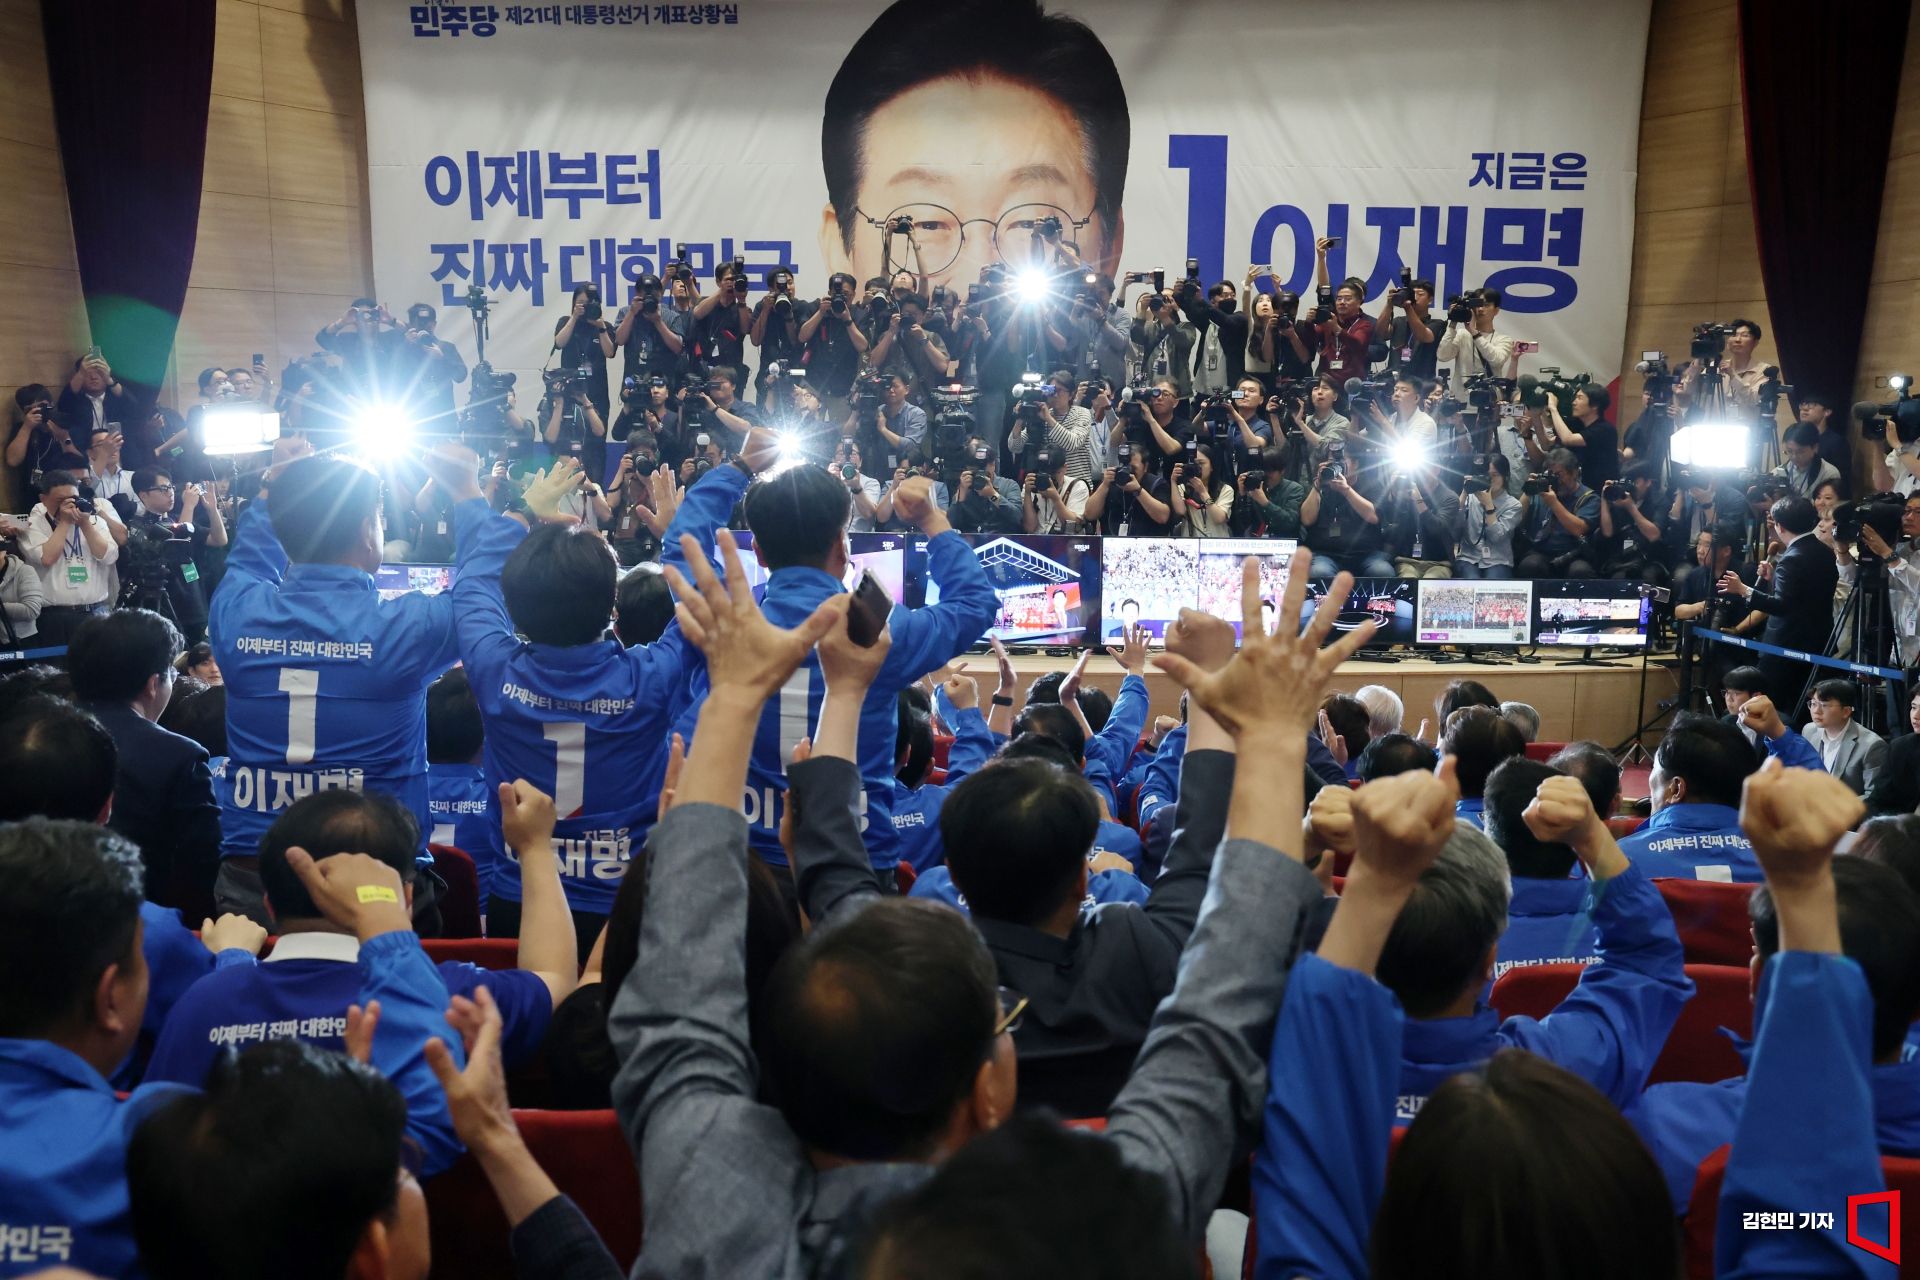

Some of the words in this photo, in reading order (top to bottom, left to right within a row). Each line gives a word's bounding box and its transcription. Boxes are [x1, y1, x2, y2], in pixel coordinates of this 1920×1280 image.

[410, 5, 499, 37] 민주당
[505, 5, 561, 25] 제21대
[565, 5, 649, 25] 대통령선거
[653, 5, 738, 25] 개표상황실
[424, 149, 662, 221] 이제부터
[1469, 152, 1588, 191] 지금은
[1168, 134, 1228, 296] 1
[430, 238, 548, 307] 진짜
[1250, 203, 1585, 314] 이재명
[236, 637, 287, 656] 이제부터
[289, 640, 316, 656] 진짜
[317, 642, 373, 659] 대한민국
[502, 683, 552, 710] 이제부터
[278, 667, 320, 764] 1
[543, 722, 586, 820] 1
[890, 812, 925, 829] 한민국
[1648, 836, 1699, 852] 이제부터
[1699, 834, 1724, 849] 진짜
[209, 1022, 266, 1045] 이제부터
[300, 1017, 347, 1037] 대한민
